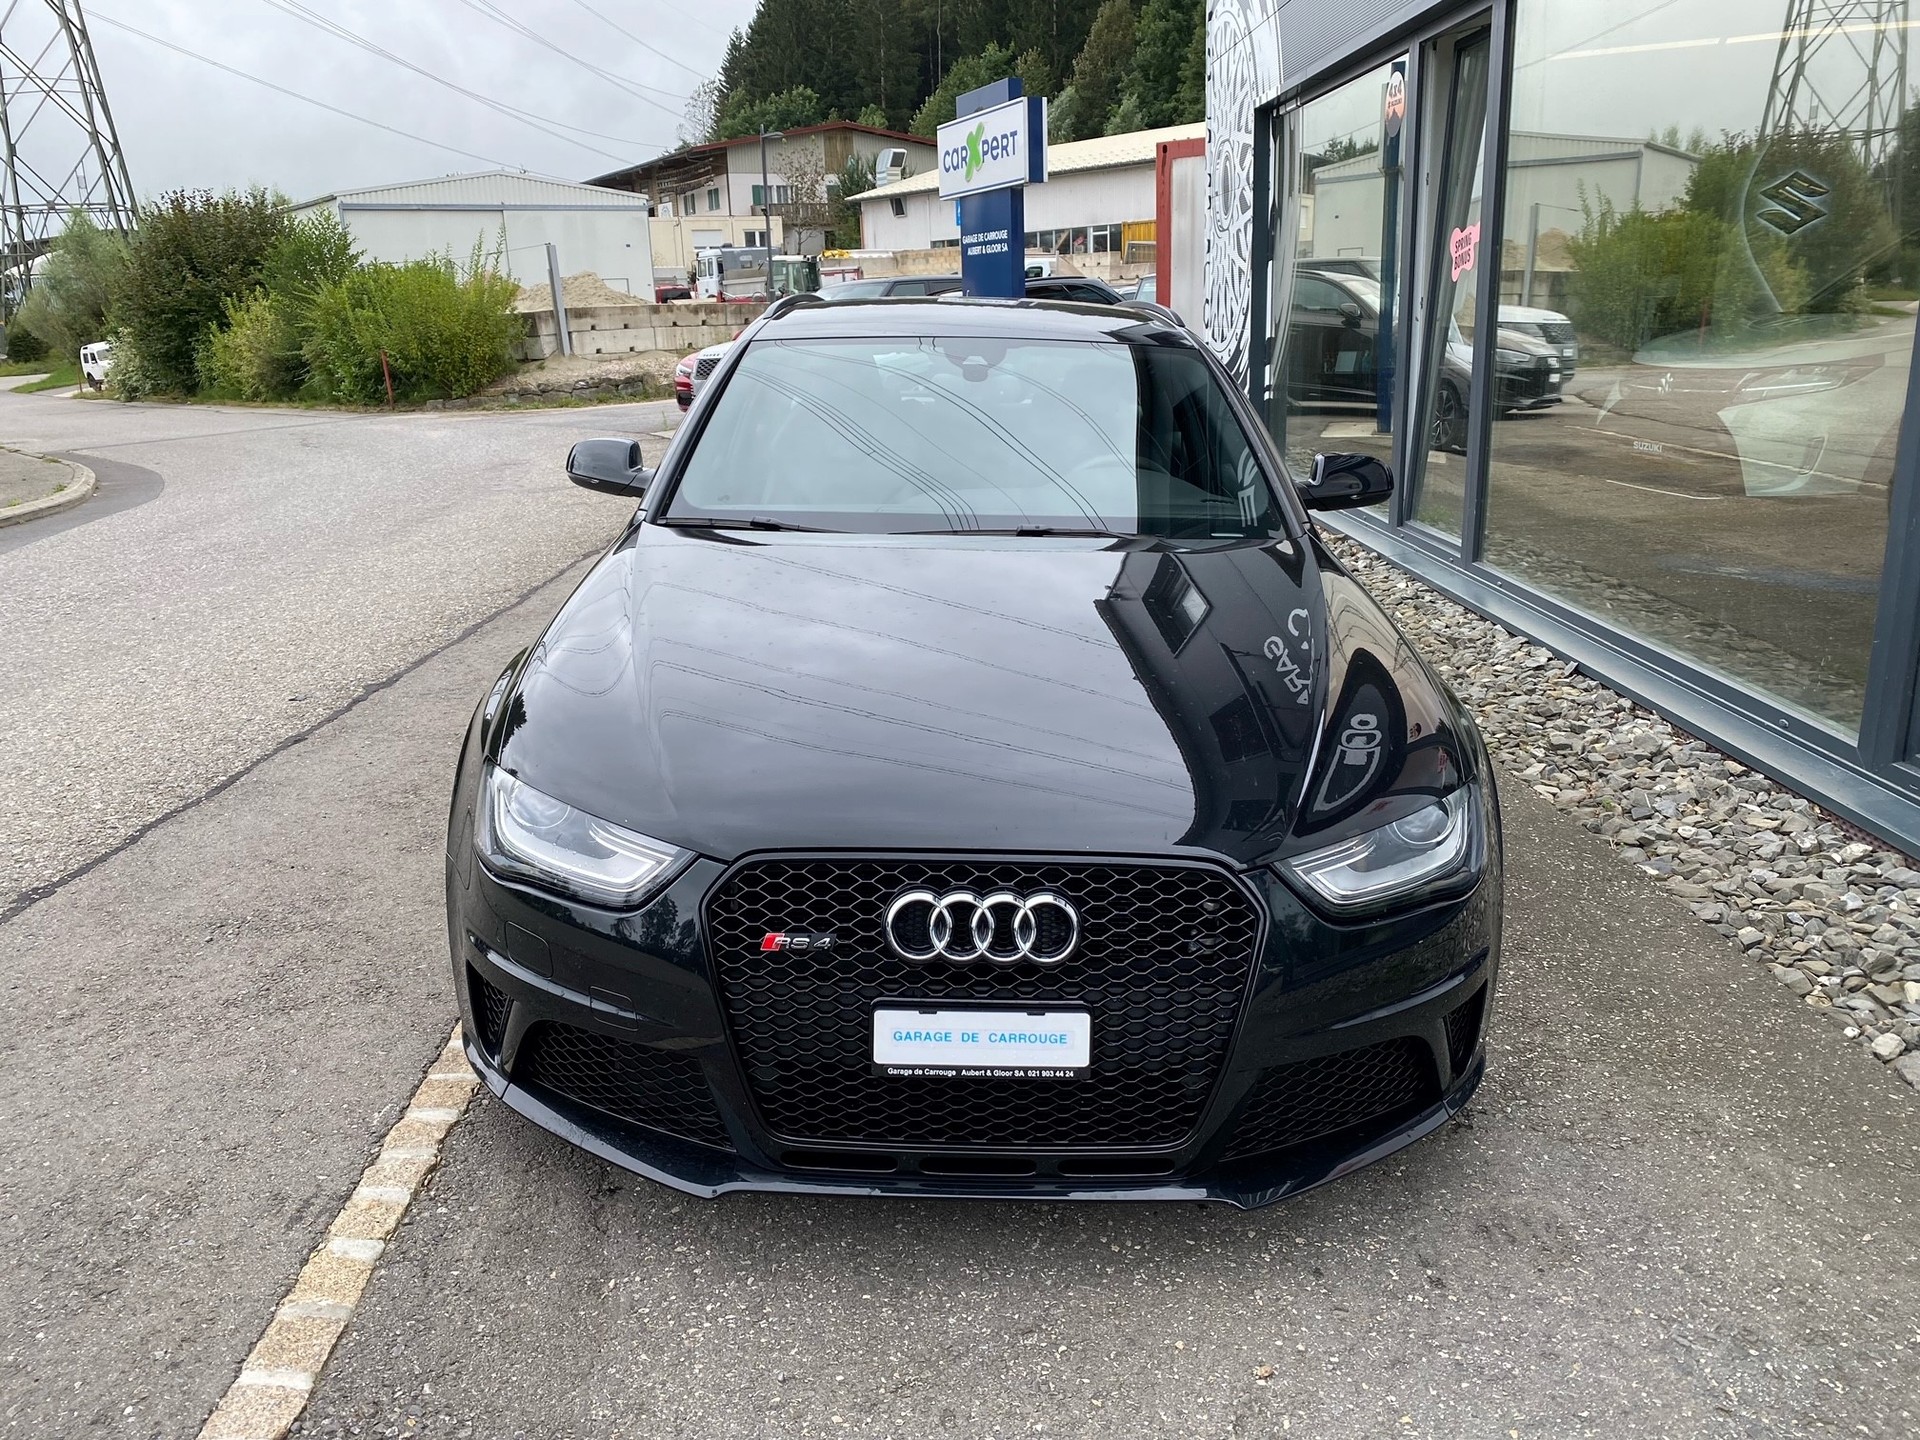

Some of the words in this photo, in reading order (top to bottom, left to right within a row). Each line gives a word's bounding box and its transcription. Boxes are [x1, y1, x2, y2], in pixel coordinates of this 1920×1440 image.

[1454, 232, 1472, 253] SPRING
[1454, 248, 1471, 270] BONUS
[1632, 440, 1663, 453] SUZUKI
[893, 1030, 953, 1043] GARAGE
[961, 1031, 980, 1043] DE
[988, 1032, 1068, 1045] CARROUGE
[887, 1067, 912, 1077] Garage
[913, 1067, 923, 1076] de
[924, 1068, 957, 1077] Carrouge
[961, 1068, 985, 1077] Aubert
[985, 1069, 992, 1077] &
[993, 1069, 1013, 1077] Gloor
[1013, 1069, 1025, 1077] SA
[1027, 1070, 1040, 1078] 021
[1041, 1070, 1054, 1078] 903
[1055, 1070, 1064, 1078] 44
[1065, 1070, 1074, 1078] 24
